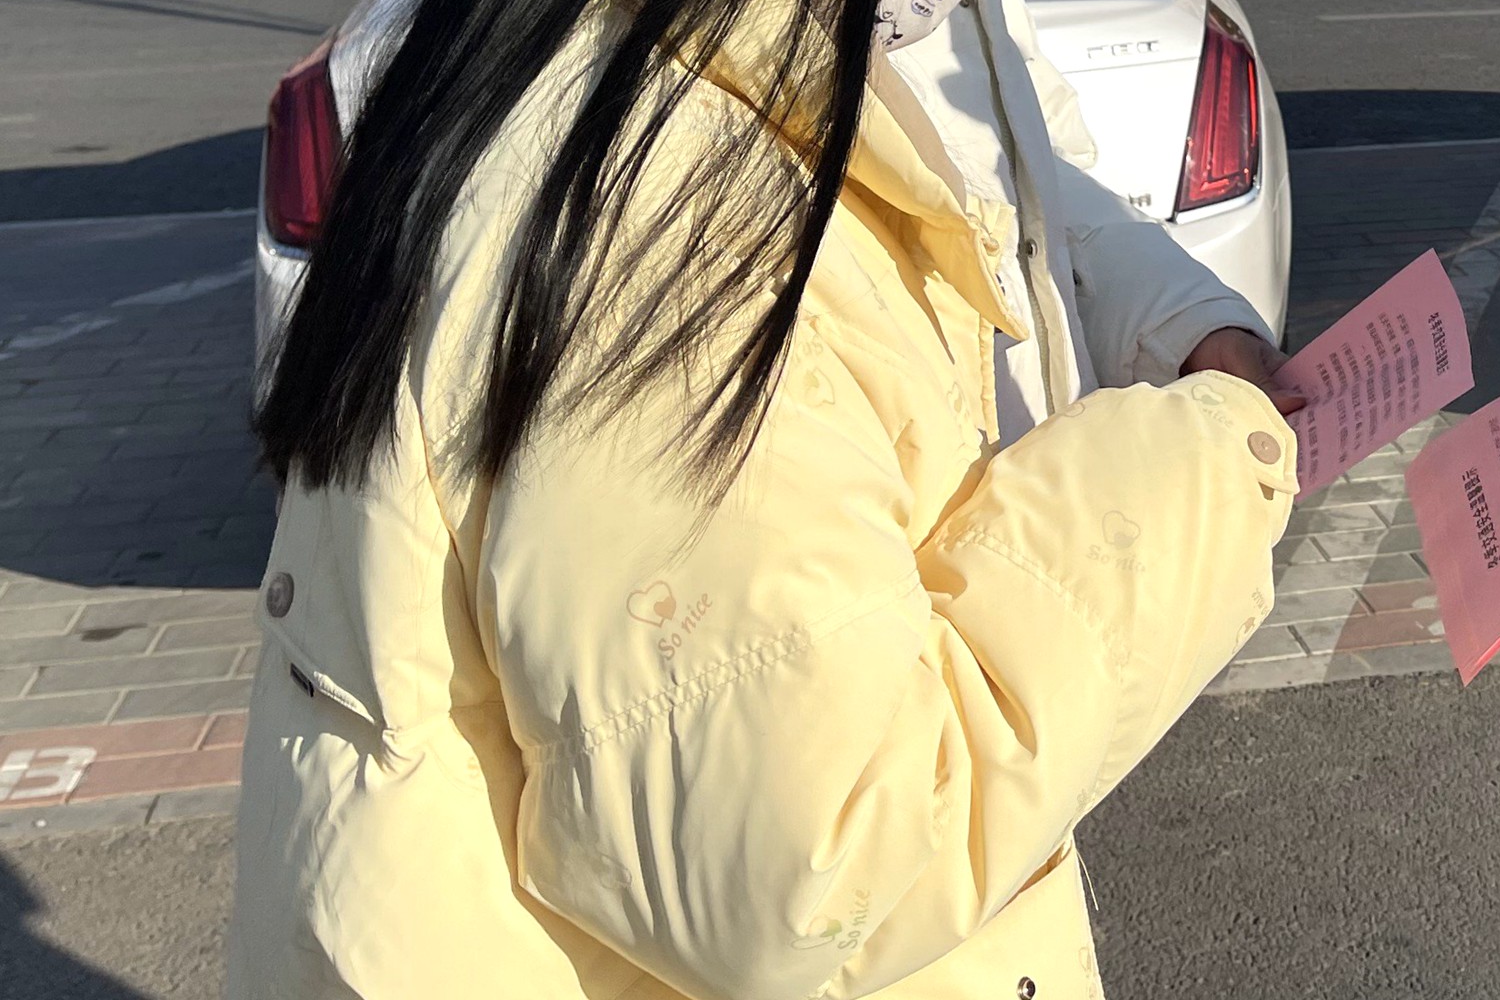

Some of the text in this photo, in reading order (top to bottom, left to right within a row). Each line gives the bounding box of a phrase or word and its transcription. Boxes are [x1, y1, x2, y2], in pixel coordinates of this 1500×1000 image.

[657, 592, 713, 661] So nice
[837, 889, 870, 950] So nice
